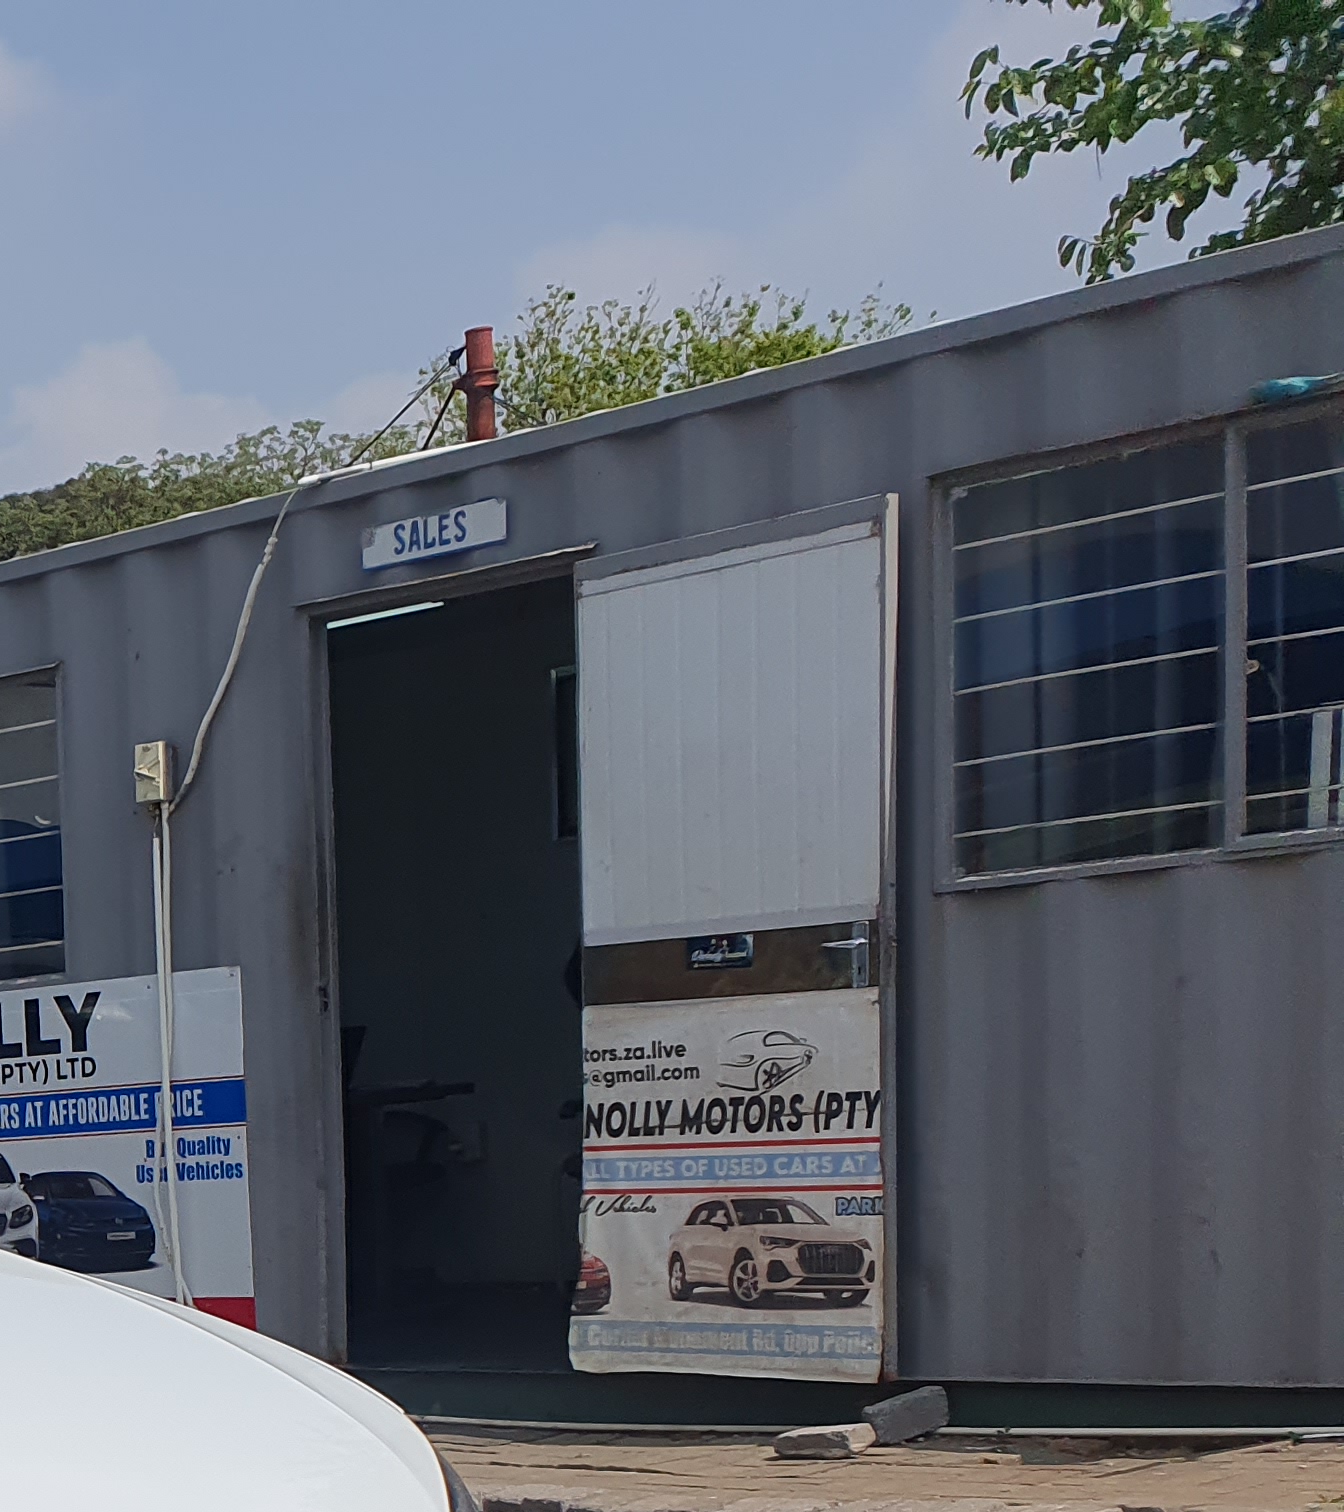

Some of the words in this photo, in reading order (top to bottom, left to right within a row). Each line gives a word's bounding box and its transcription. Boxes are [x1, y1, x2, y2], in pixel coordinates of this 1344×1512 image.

[393, 510, 467, 555] SALES
[56, 1057, 97, 1080] LTD
[25, 1101, 44, 1128] AT
[48, 1092, 149, 1127] AFFORDABLE
[584, 1099, 673, 1139] NOLLY
[679, 1093, 805, 1135] MOTORS
[176, 1135, 231, 1158] Quality
[175, 1160, 244, 1182] Vehicles
[616, 1159, 675, 1178] TYPES
[681, 1158, 709, 1177] OF
[714, 1157, 767, 1176] USED
[774, 1155, 833, 1175] CARS
[839, 1154, 867, 1173] AT
